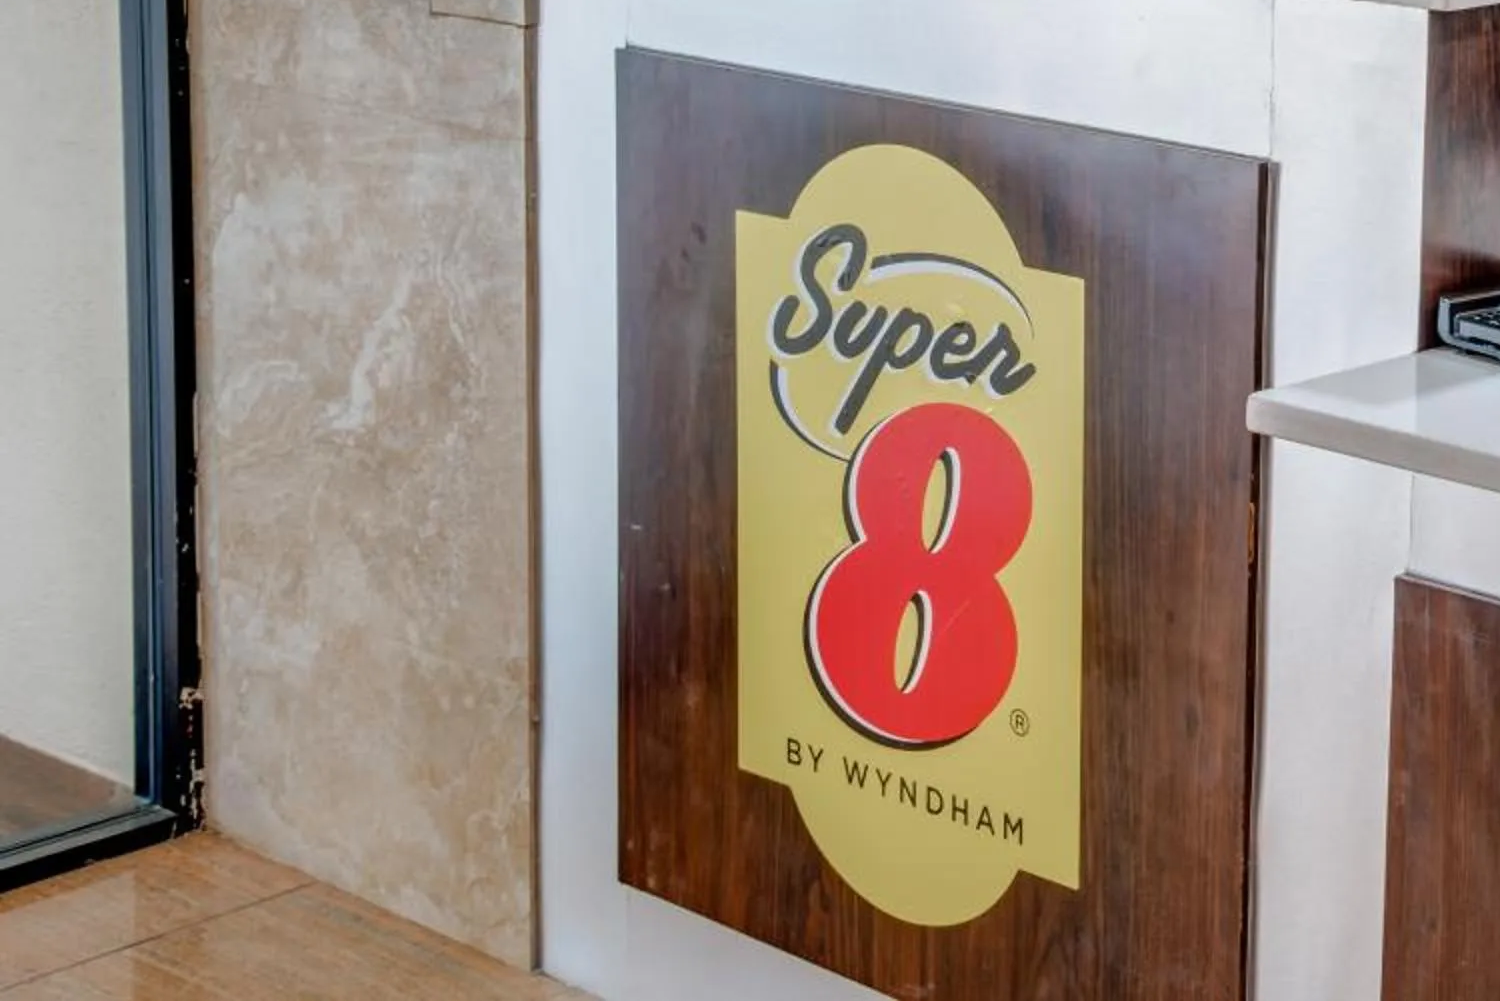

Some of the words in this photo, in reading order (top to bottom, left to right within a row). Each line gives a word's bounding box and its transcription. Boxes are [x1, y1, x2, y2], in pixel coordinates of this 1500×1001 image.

[770, 223, 1037, 437] Super
[804, 402, 1033, 750] 8
[787, 737, 824, 773] BY
[843, 755, 1024, 846] WYNDHAM
